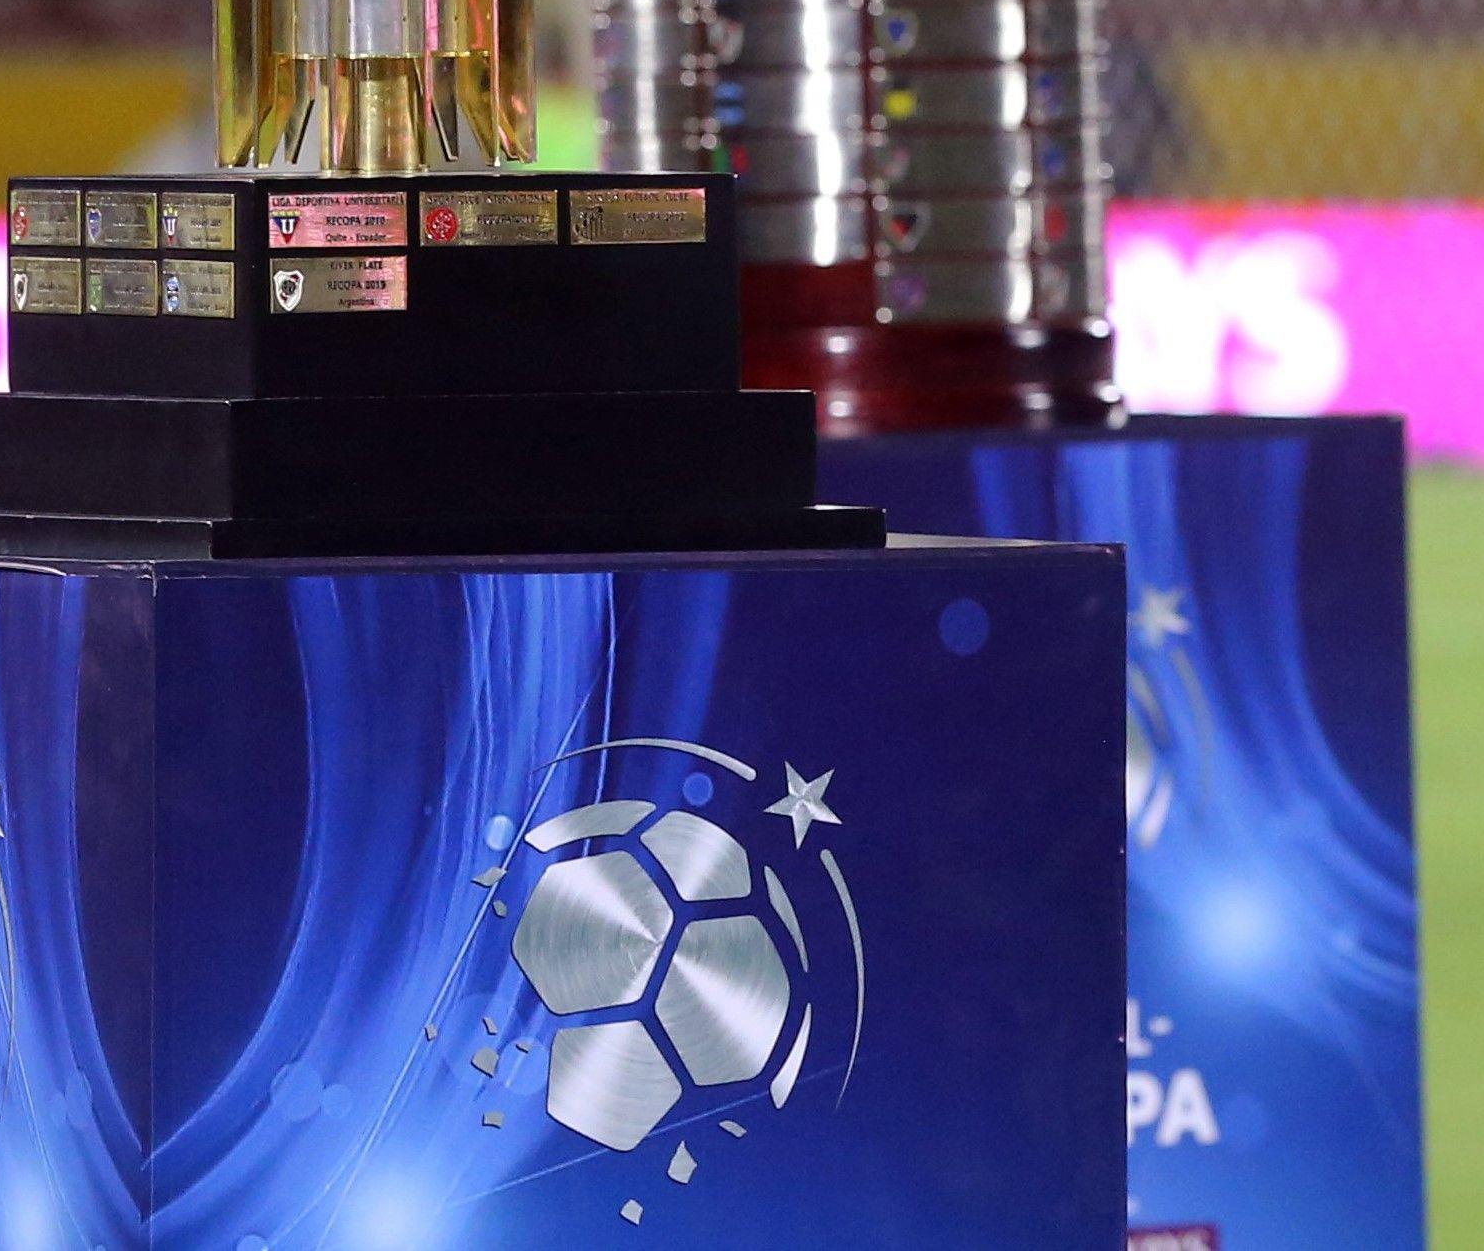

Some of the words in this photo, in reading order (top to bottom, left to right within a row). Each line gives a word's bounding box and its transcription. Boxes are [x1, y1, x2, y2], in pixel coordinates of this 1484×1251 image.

[272, 197, 291, 207] LIGA
[296, 196, 339, 207] DEPORTIVA
[326, 216, 361, 226] RECOPA
[359, 260, 383, 270] PLATE
[327, 280, 362, 290] RECOPA
